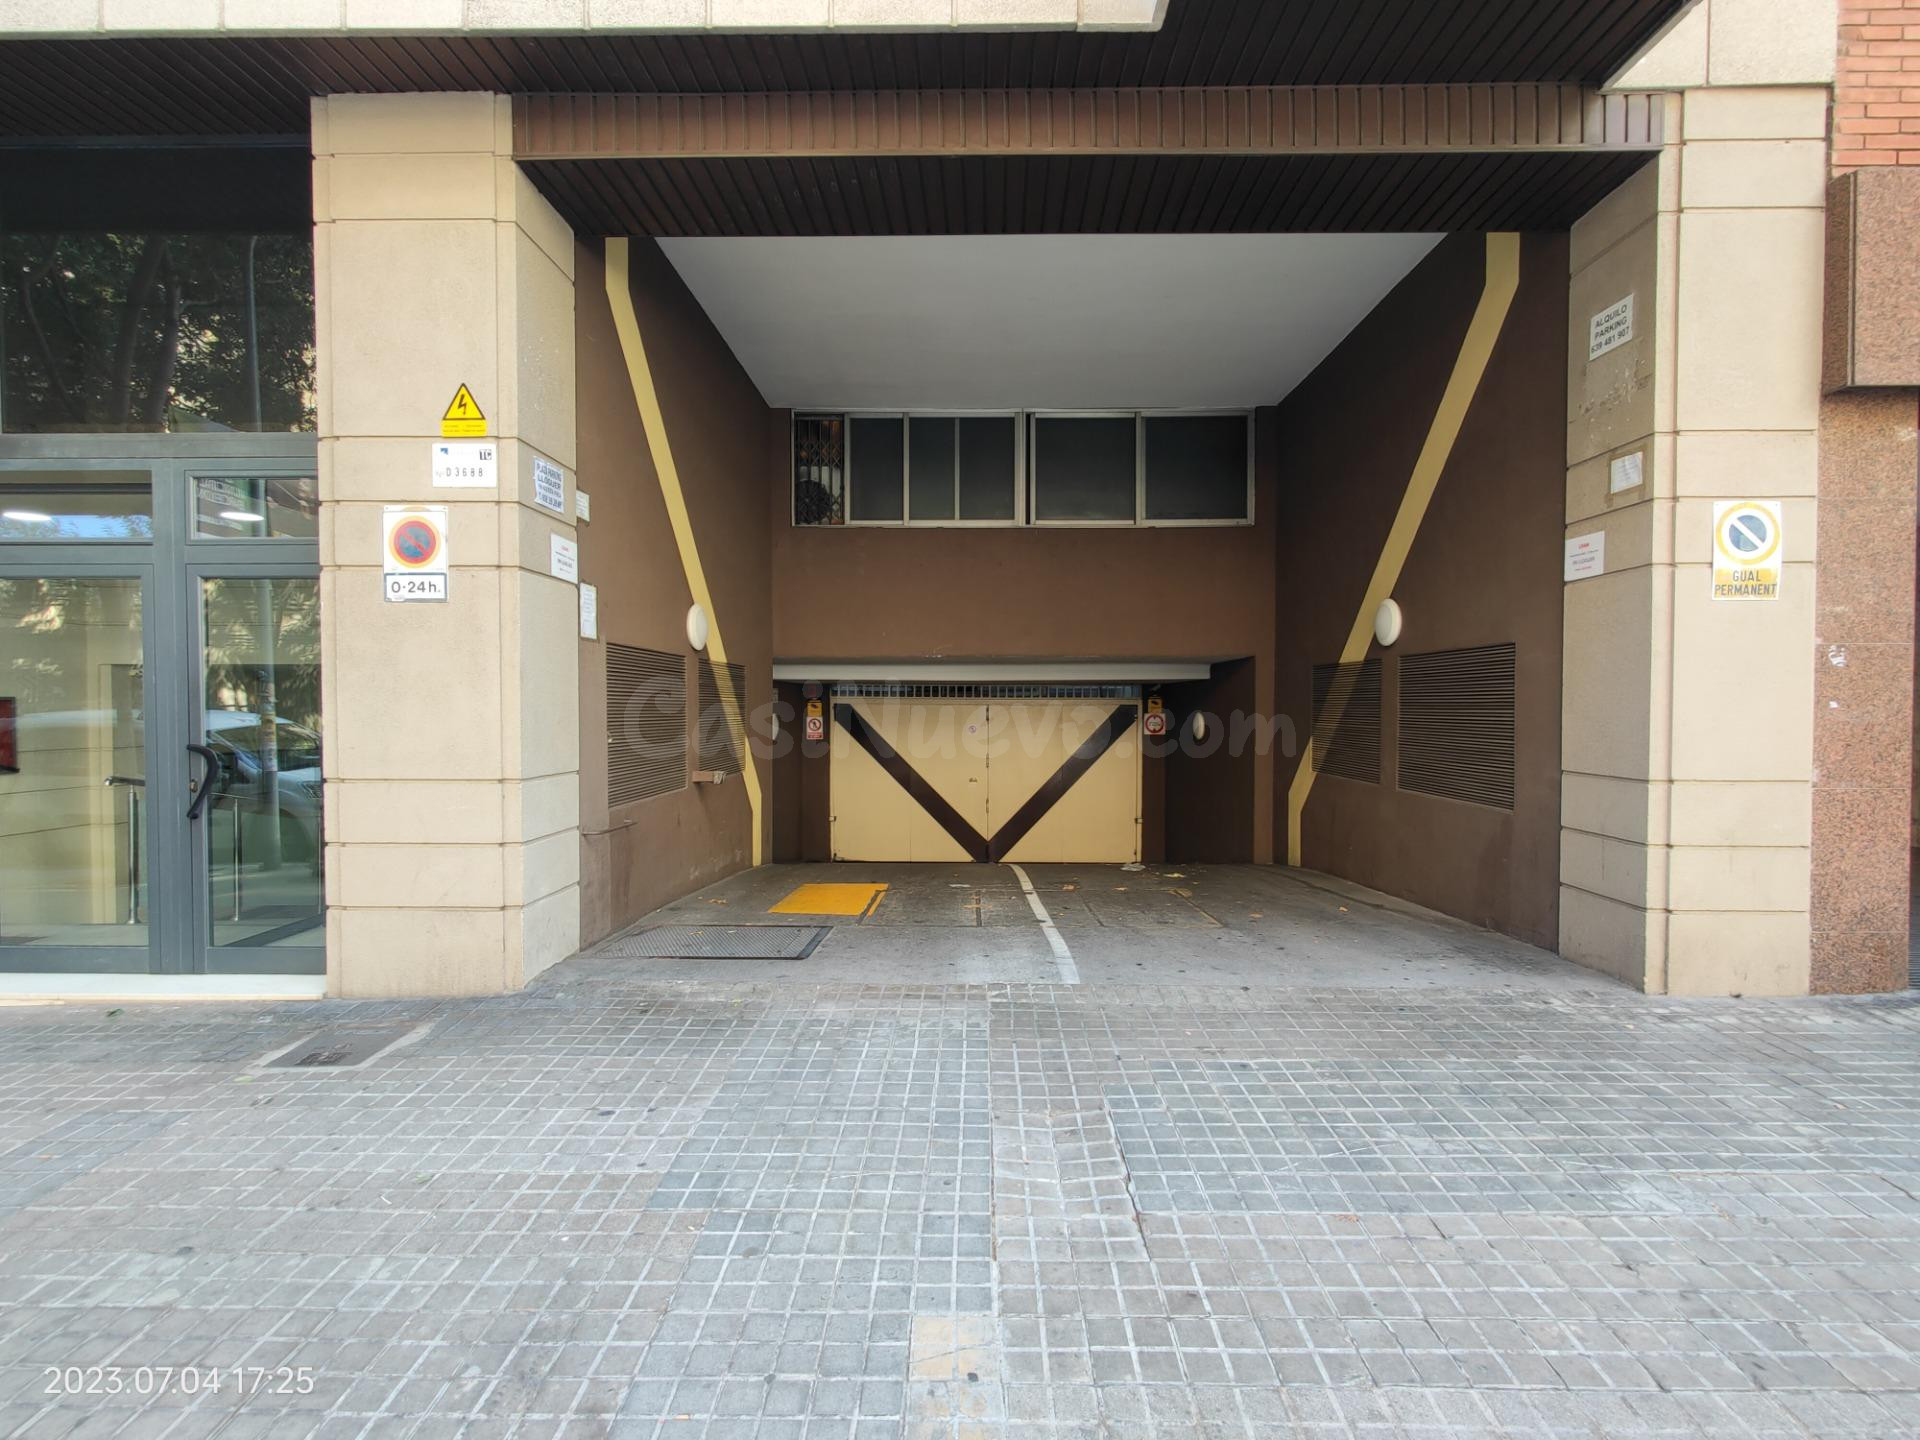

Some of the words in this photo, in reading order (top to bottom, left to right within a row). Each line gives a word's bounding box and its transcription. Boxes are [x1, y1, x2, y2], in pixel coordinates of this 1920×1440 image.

[1595, 304, 1627, 329] ALQUILO
[1595, 316, 1627, 341] PARKING
[1733, 569, 1762, 582] GUAL
[1714, 583, 1777, 596] PERMANENT
